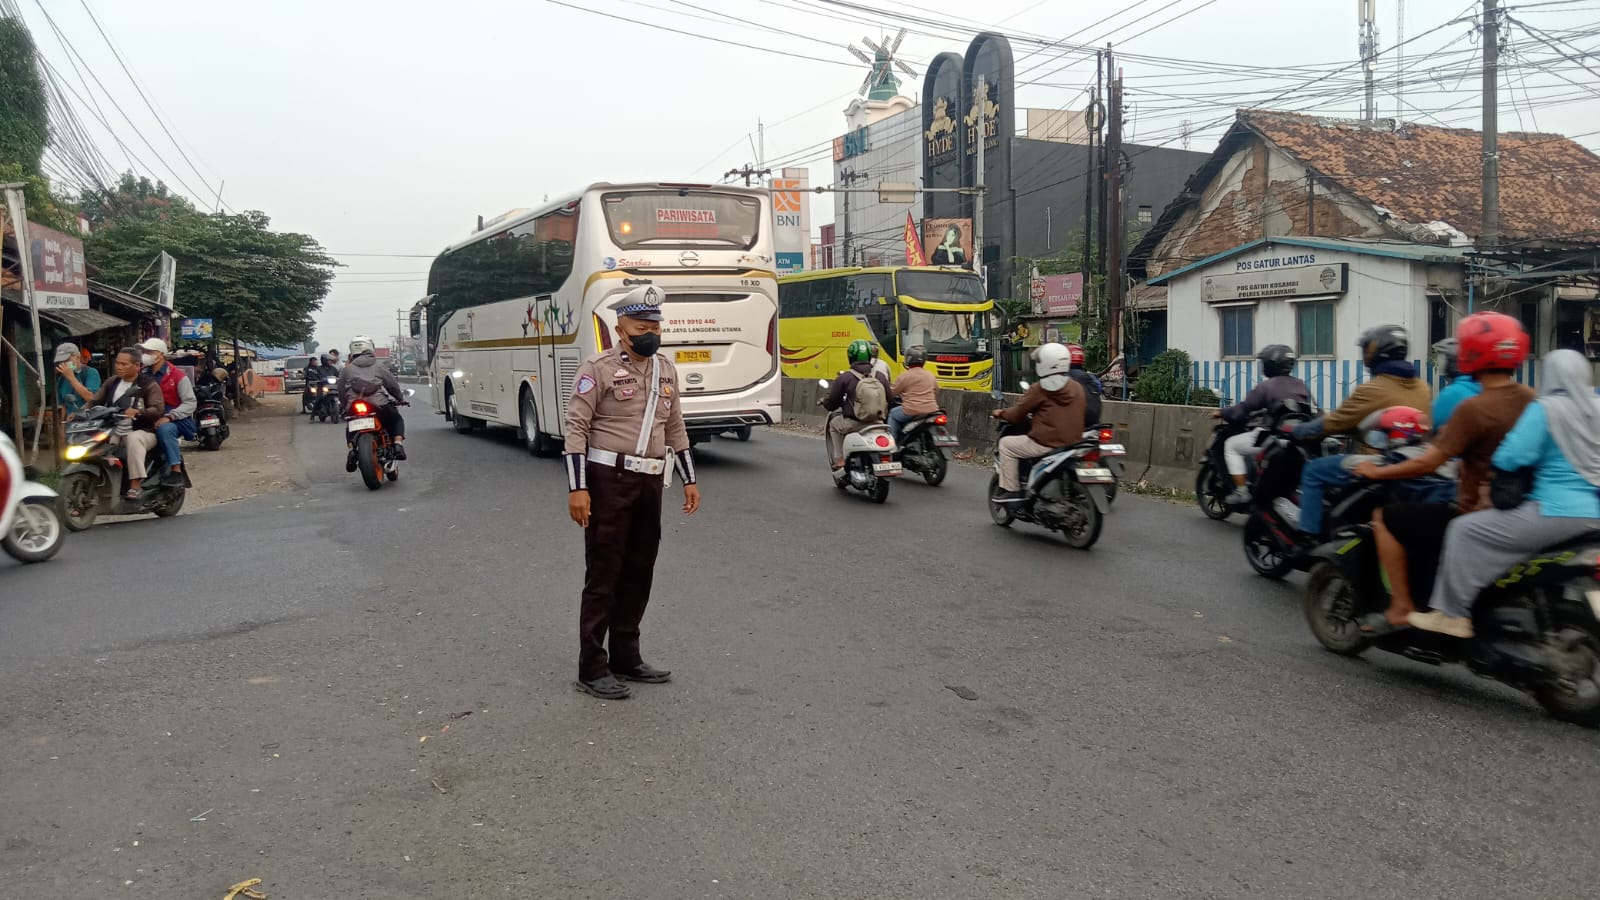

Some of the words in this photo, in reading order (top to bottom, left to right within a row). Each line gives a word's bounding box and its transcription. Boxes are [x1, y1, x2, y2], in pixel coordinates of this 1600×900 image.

[928, 136, 954, 157] HYDE
[657, 209, 715, 222] PARIWISATA
[777, 215, 800, 226] BNI
[1236, 262, 1252, 271] POS
[1253, 259, 1280, 268] GATUR
[1282, 255, 1315, 265] LANTAS
